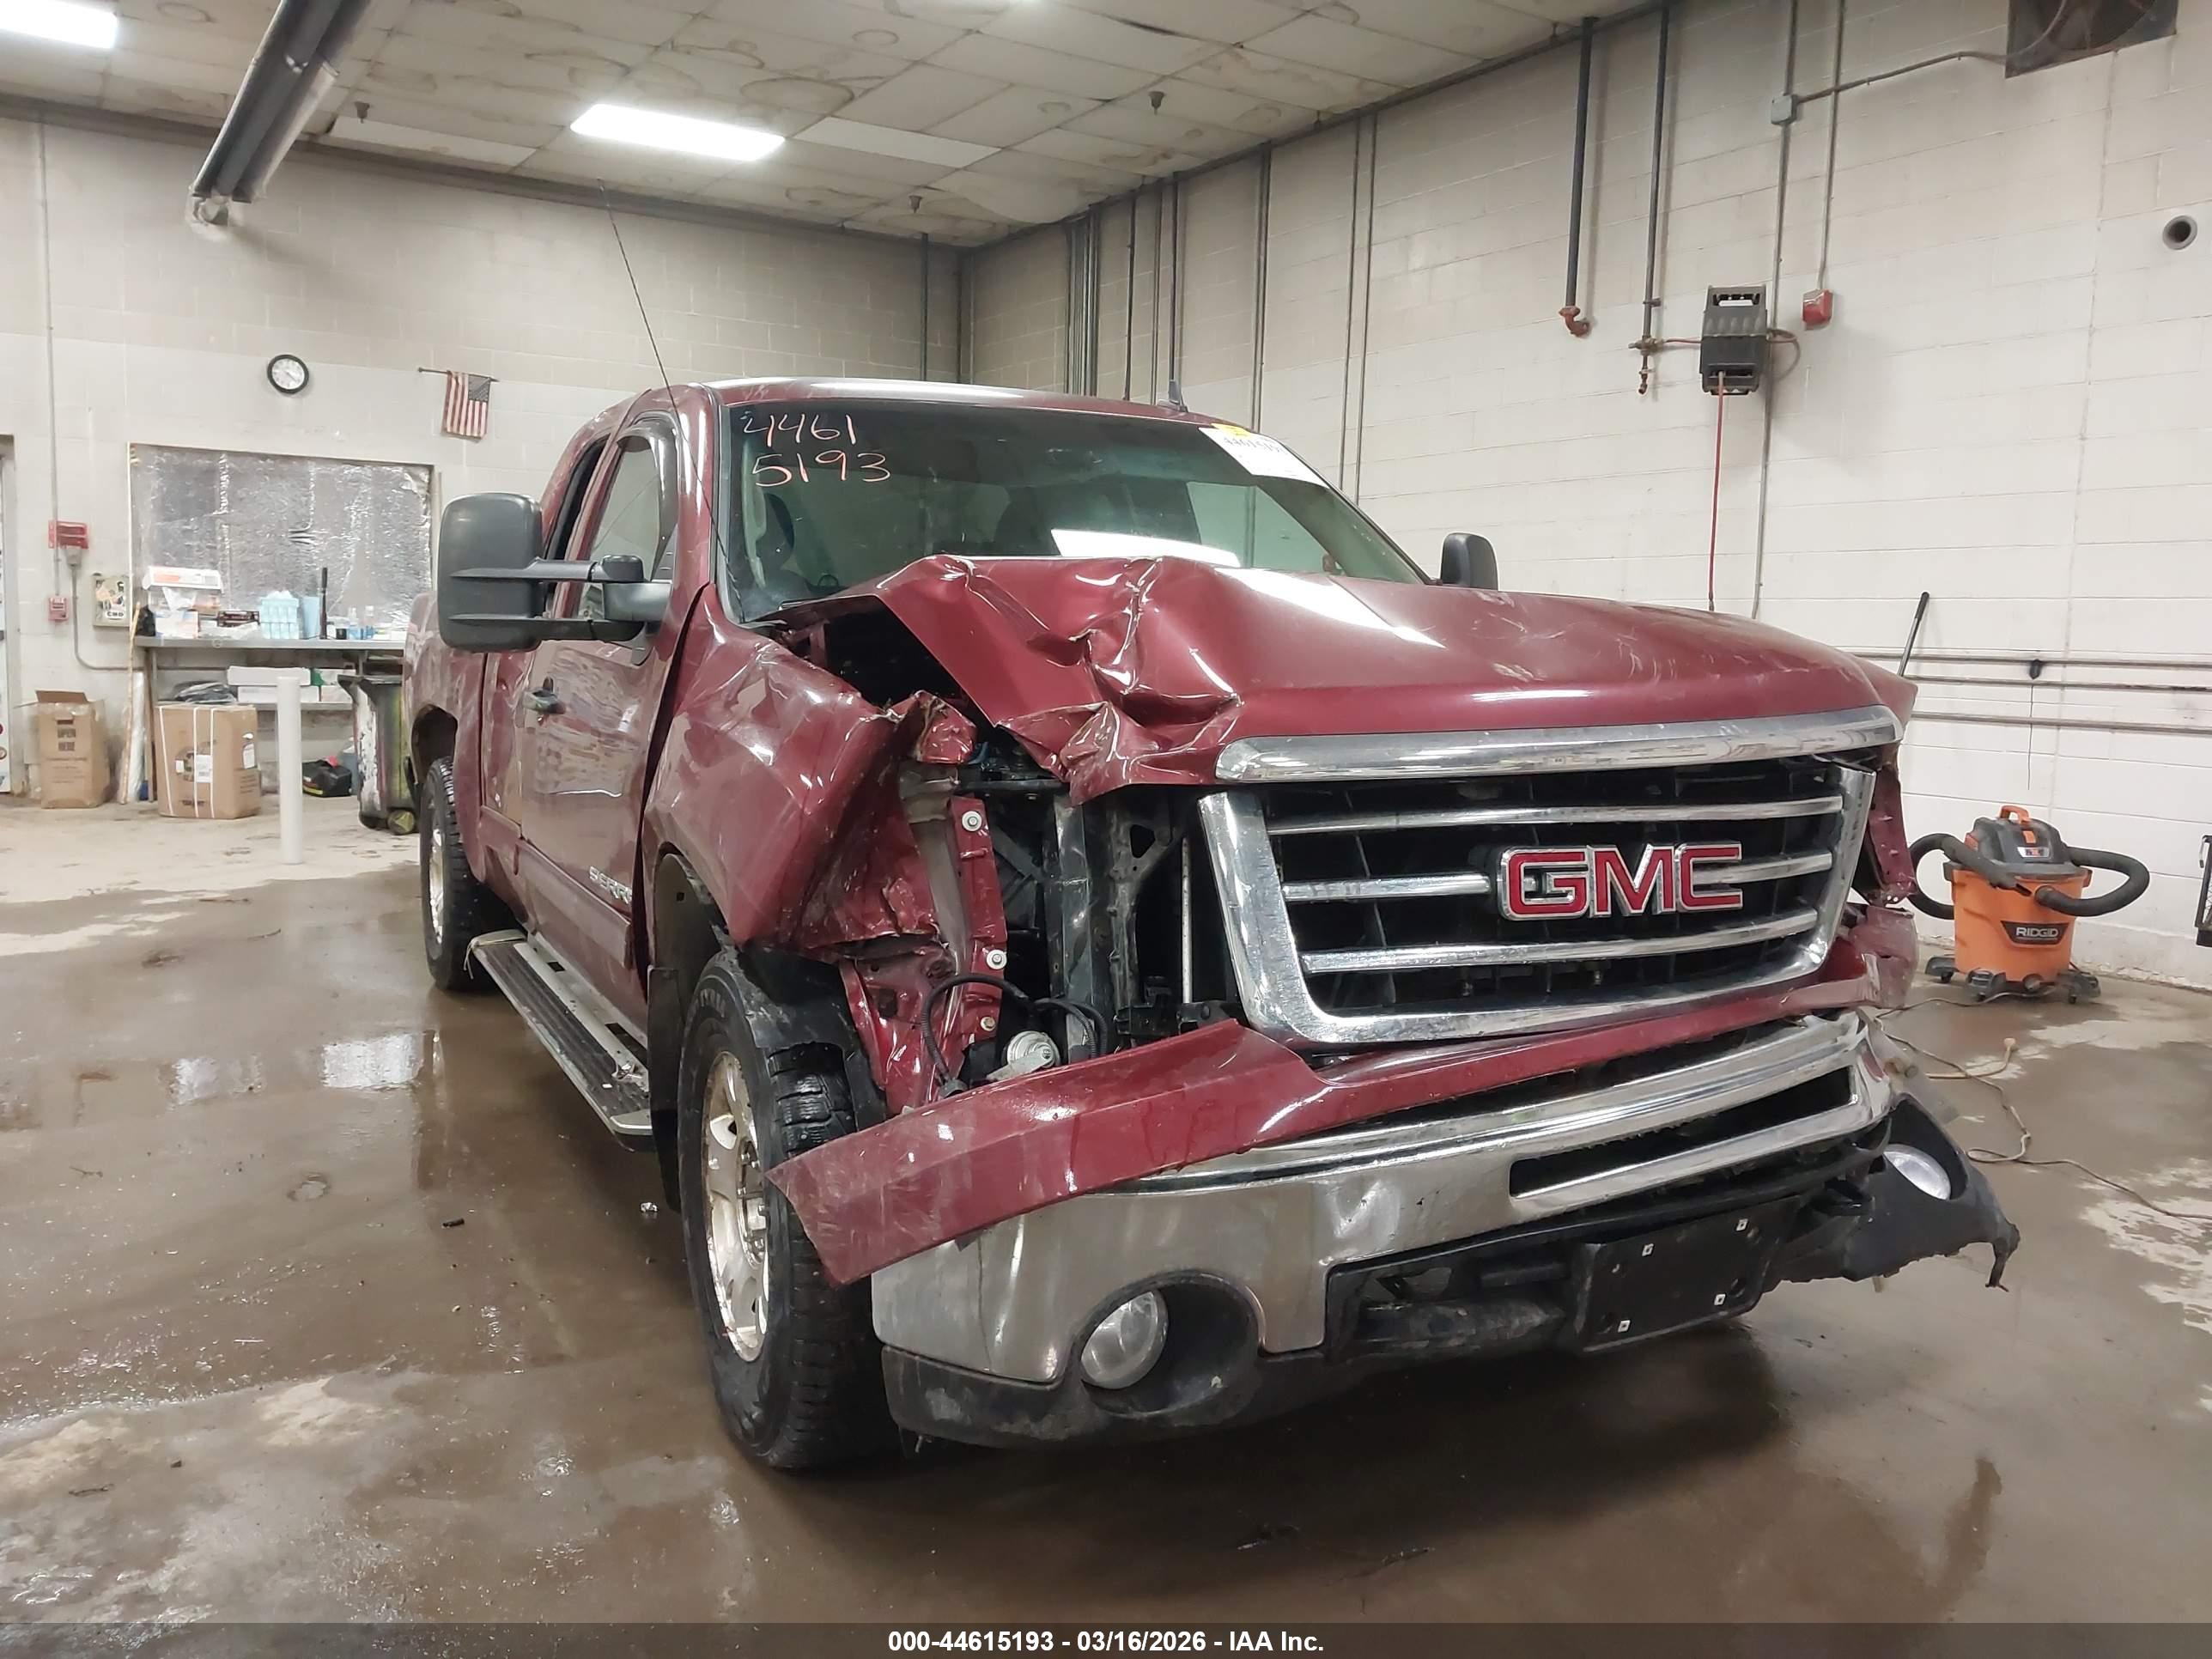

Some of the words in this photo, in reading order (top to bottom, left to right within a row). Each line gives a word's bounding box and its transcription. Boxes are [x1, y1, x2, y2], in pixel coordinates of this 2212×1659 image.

[743, 413, 856, 447] 4461
[751, 449, 891, 487] 5193
[1498, 842, 1743, 921] GMC
[2015, 927, 2059, 938] RIDGID
